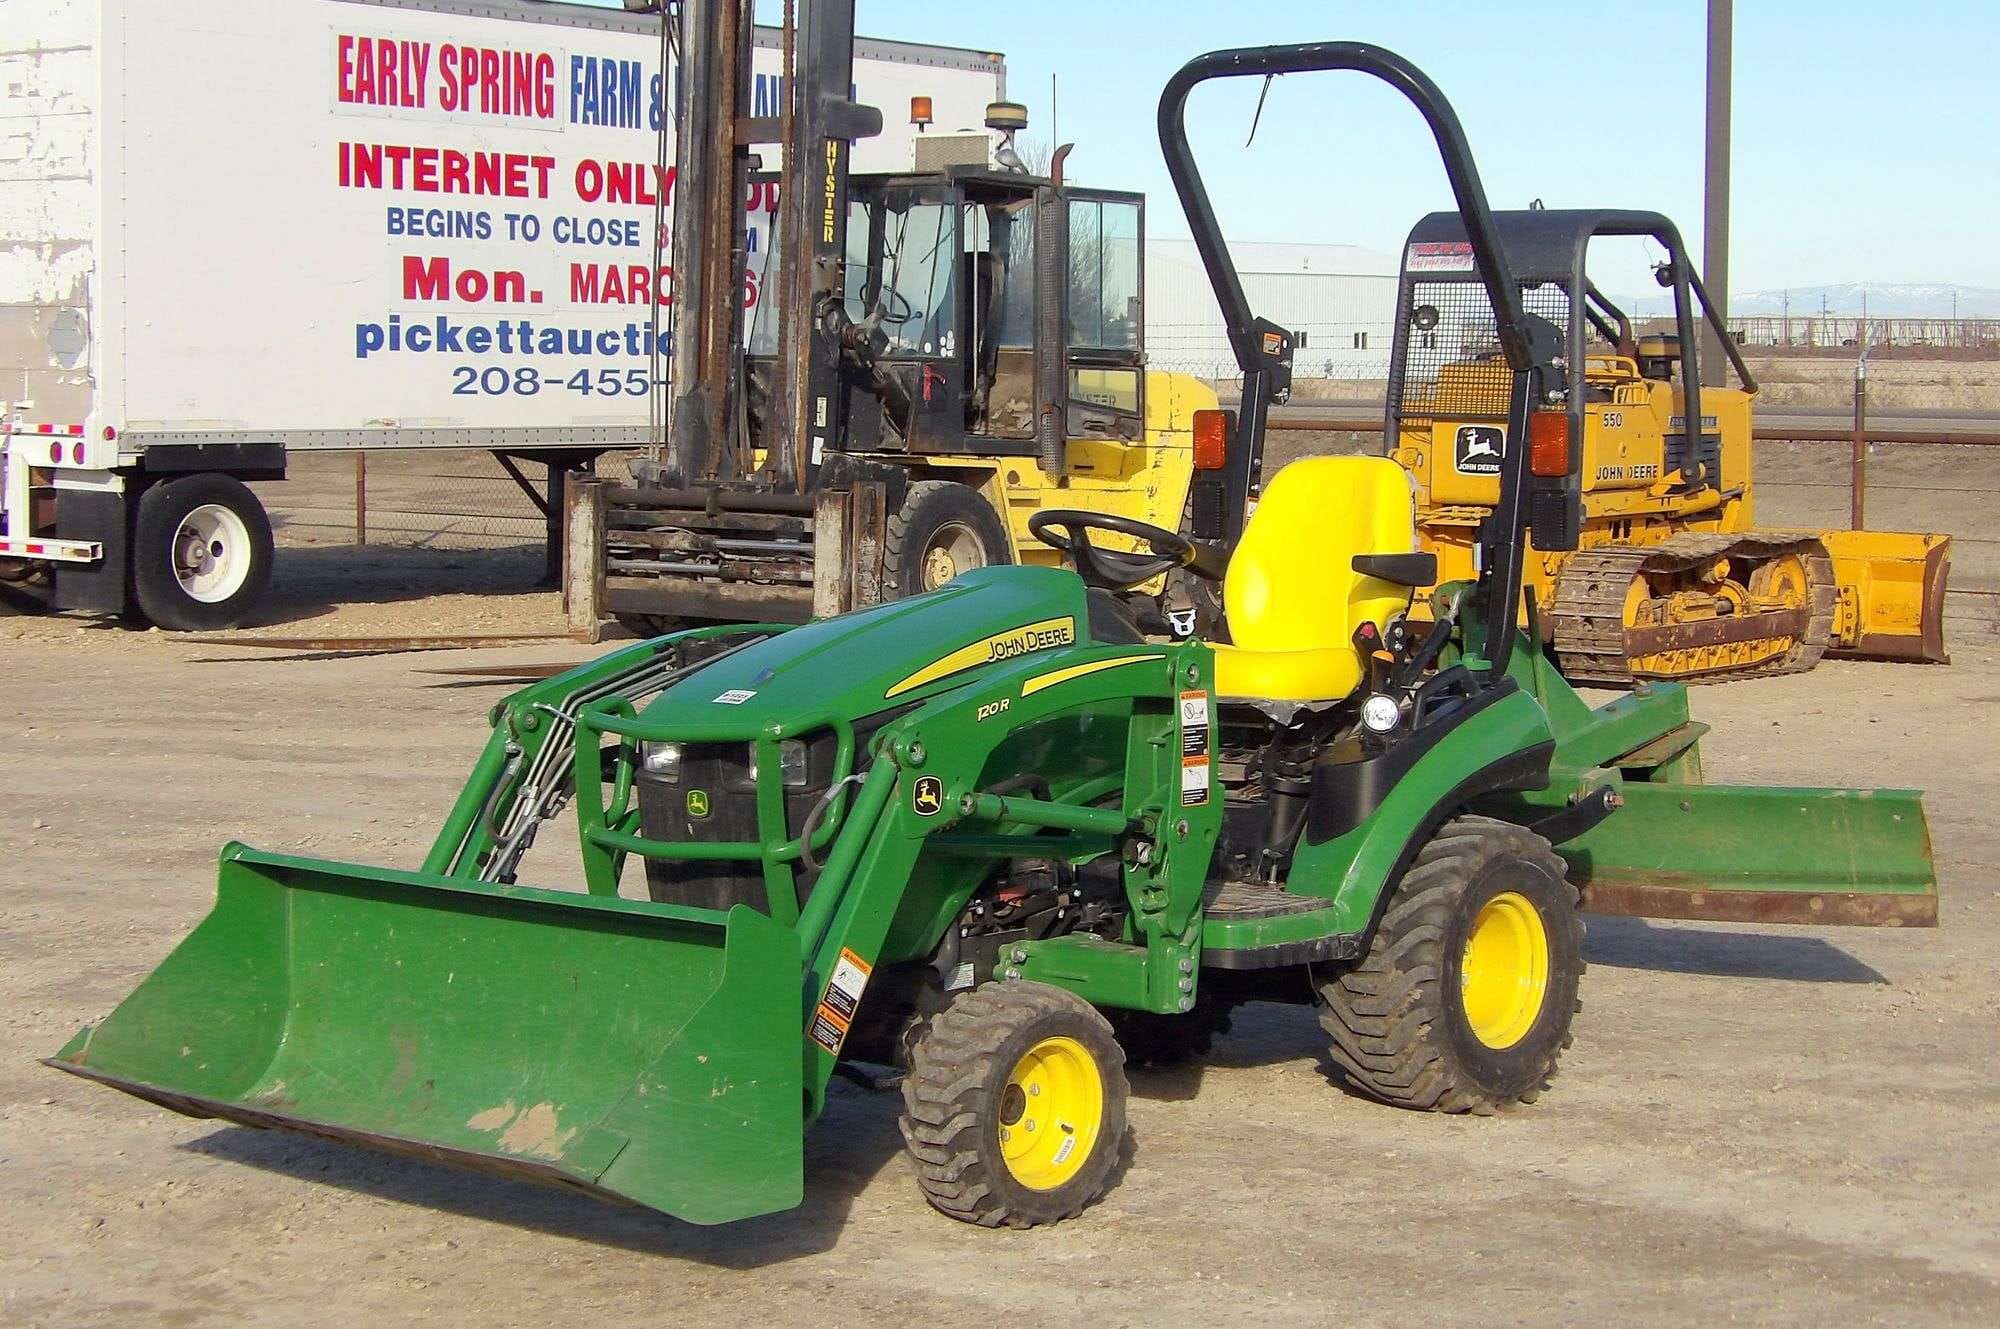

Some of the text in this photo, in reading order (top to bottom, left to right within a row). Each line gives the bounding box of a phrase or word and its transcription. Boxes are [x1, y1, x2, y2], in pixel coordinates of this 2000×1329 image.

[338, 34, 431, 108] EARLY
[439, 42, 555, 119] SPRING
[571, 54, 642, 129] FARM
[338, 142, 677, 206] INTERNET ONLY
[823, 140, 838, 242] HYSTER
[387, 206, 491, 239] BEGINS
[505, 213, 540, 242] TO
[553, 217, 641, 247] CLOSE
[402, 256, 675, 308] Mon. MARC
[452, 366, 673, 396] 208-455-
[1603, 414, 1623, 428] 550
[1458, 463, 1476, 471] JOHN
[1596, 466, 1623, 480] JOHN
[988, 627, 1070, 661] JOHN DEERE
